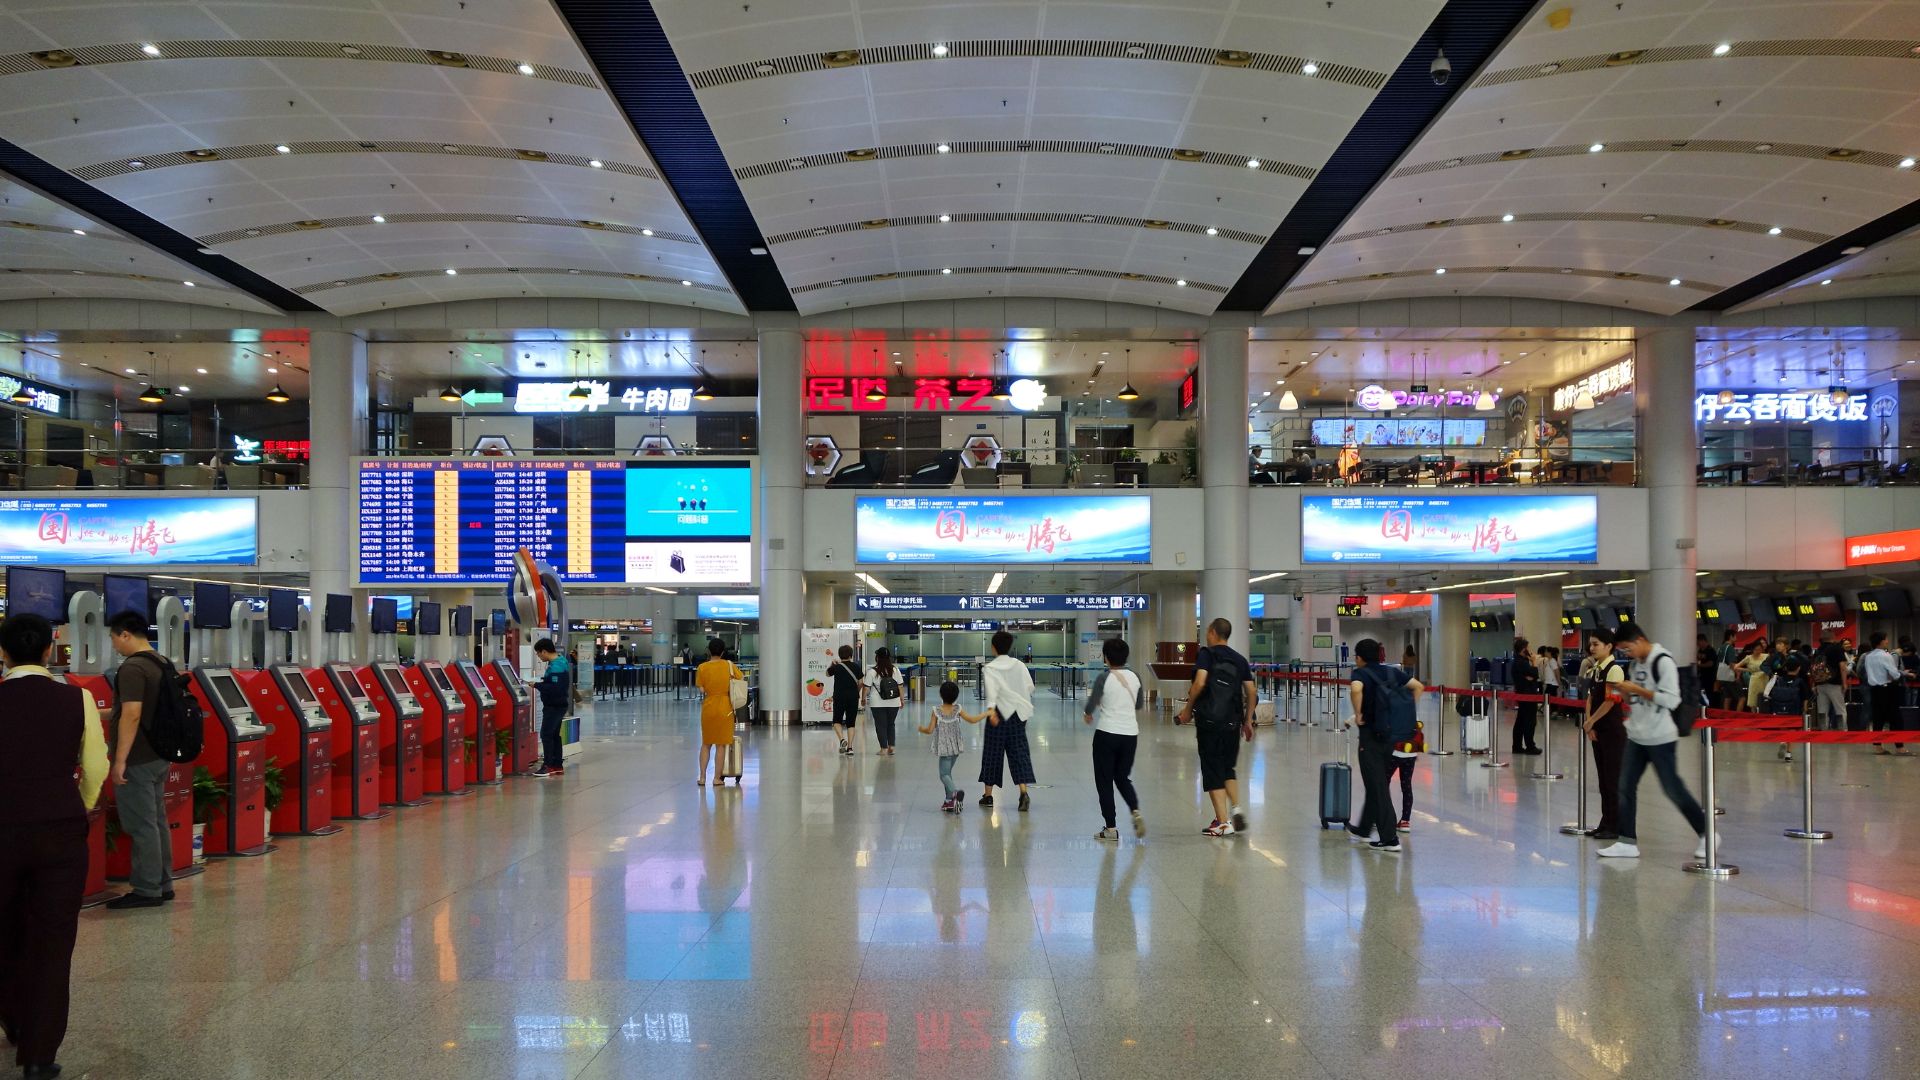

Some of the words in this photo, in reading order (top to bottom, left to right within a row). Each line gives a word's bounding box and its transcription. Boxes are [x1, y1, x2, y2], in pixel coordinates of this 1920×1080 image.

[620, 387, 693, 412] 牛肉面
[913, 378, 992, 411] 茶艺
[1391, 391, 1444, 407] Dairy
[1778, 606, 1792, 616] K15
[1800, 605, 1814, 615] K14
[1862, 602, 1878, 612] K13
